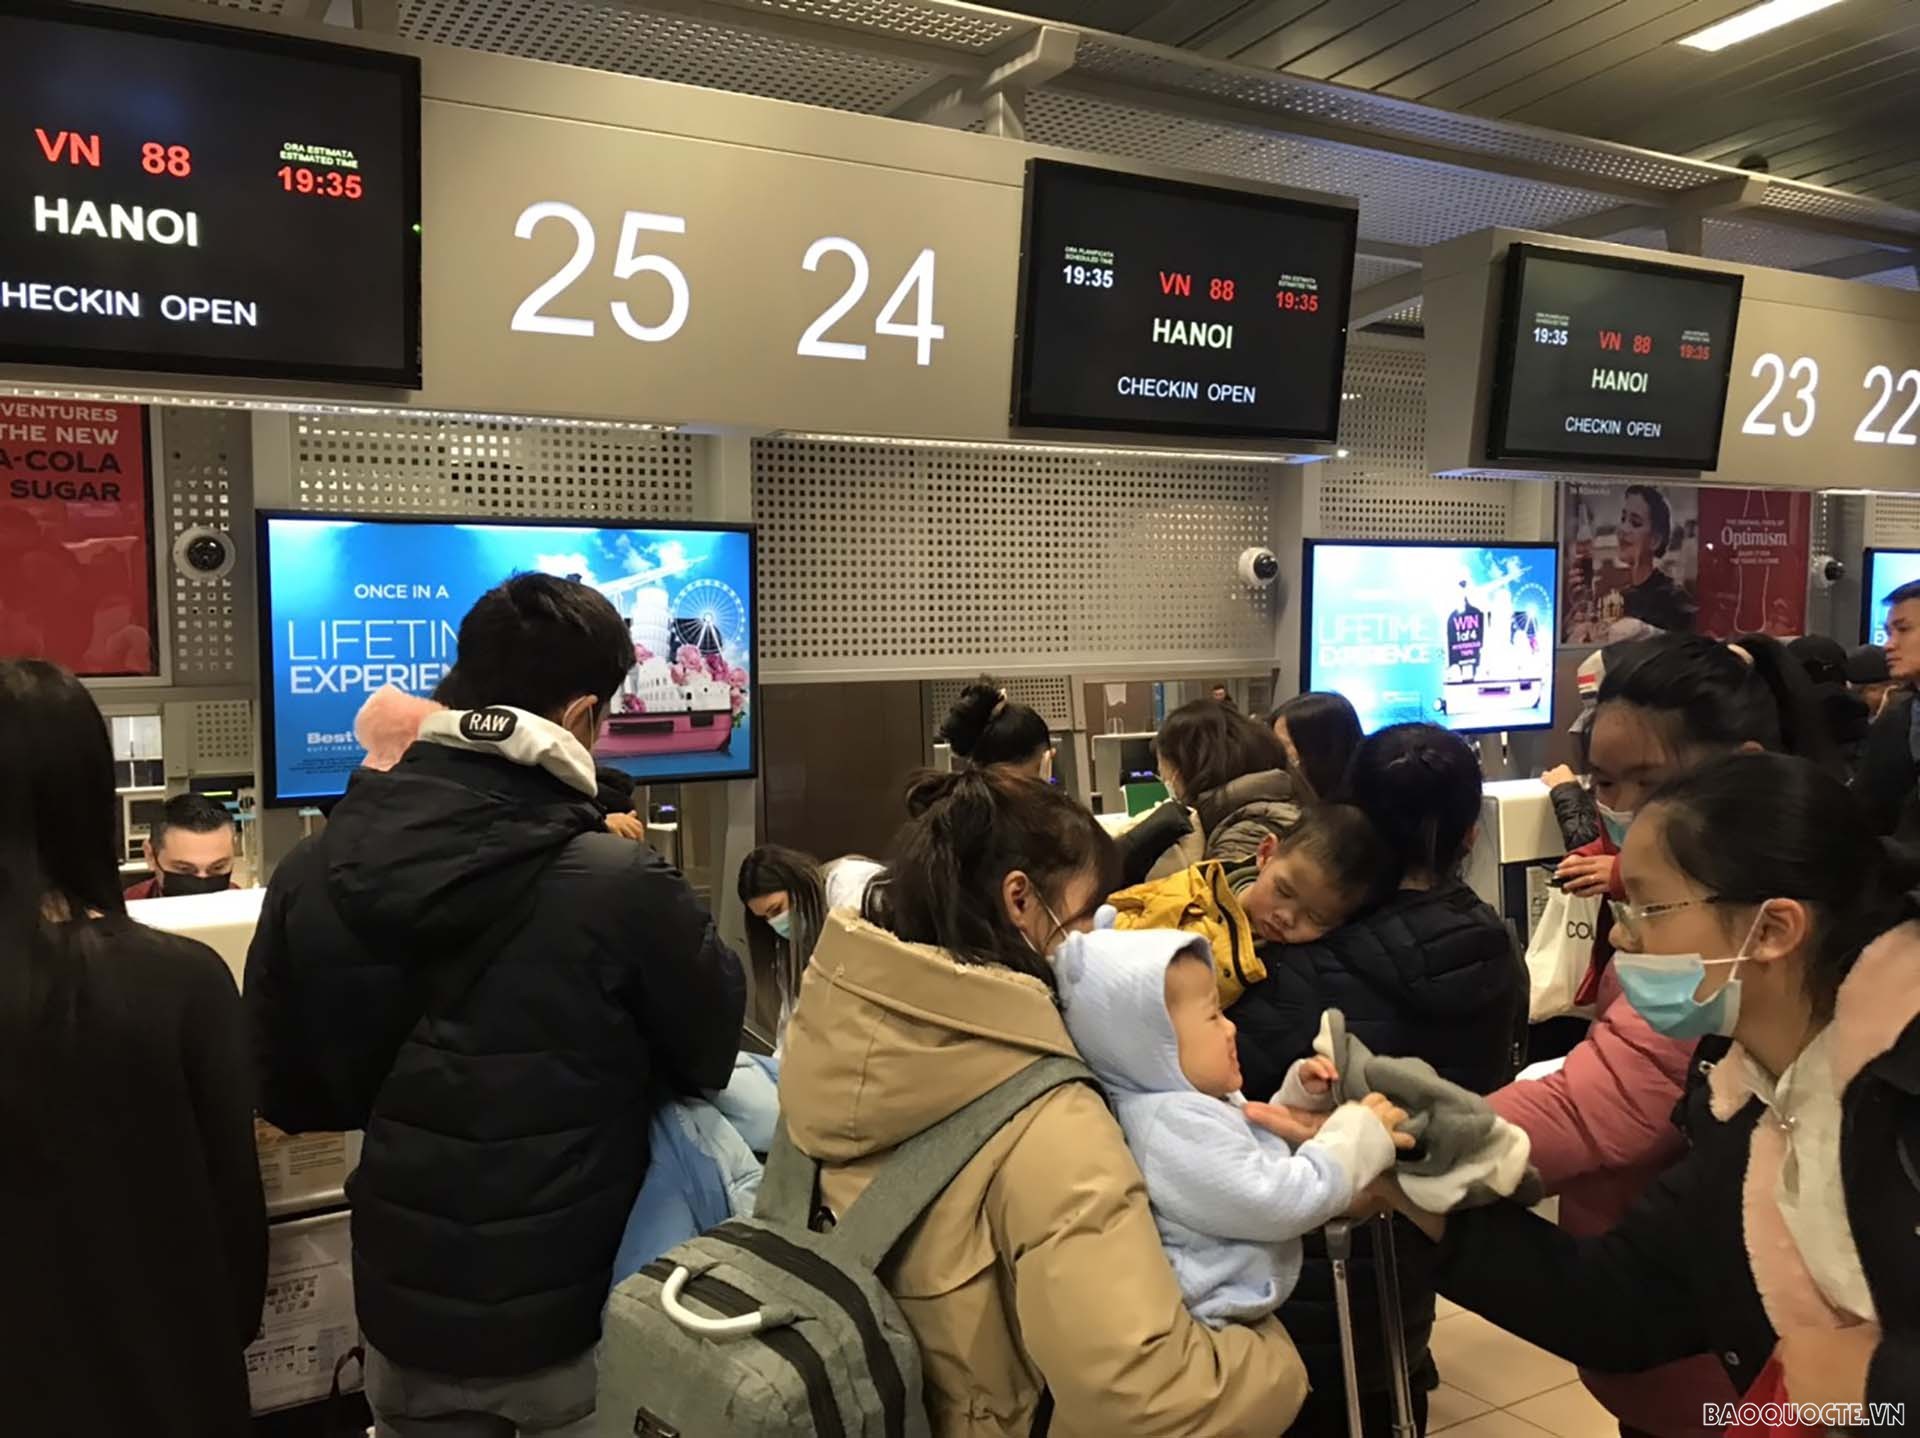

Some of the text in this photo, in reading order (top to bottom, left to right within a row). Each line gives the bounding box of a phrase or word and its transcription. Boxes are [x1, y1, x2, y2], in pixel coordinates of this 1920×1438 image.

[35, 128, 191, 177] VN 88
[278, 166, 362, 199] 19:35
[34, 195, 200, 247] HANOI
[510, 199, 690, 342] 25
[1063, 264, 1114, 288] 19:35
[1159, 271, 1235, 301] VN 88
[160, 295, 257, 326] OPEN
[797, 236, 944, 366] 24
[1276, 291, 1318, 312] 19:35
[1152, 317, 1232, 349] HANOI
[1533, 327, 1568, 346] 19:35
[1600, 330, 1652, 354] VN 88
[1117, 376, 1256, 403] CHECKIN OPEN
[1591, 368, 1648, 393] HANOI
[1742, 352, 1819, 437] 23
[1854, 365, 1920, 445] 22
[56, 427, 118, 445] NEW
[1565, 416, 1661, 438] CHECKIN OPEN
[11, 479, 121, 502] SUGAR
[1721, 526, 1788, 550] Optimism
[354, 583, 449, 600] ONCE IN A
[1453, 614, 1480, 630] WIN
[469, 713, 510, 732] RAW
